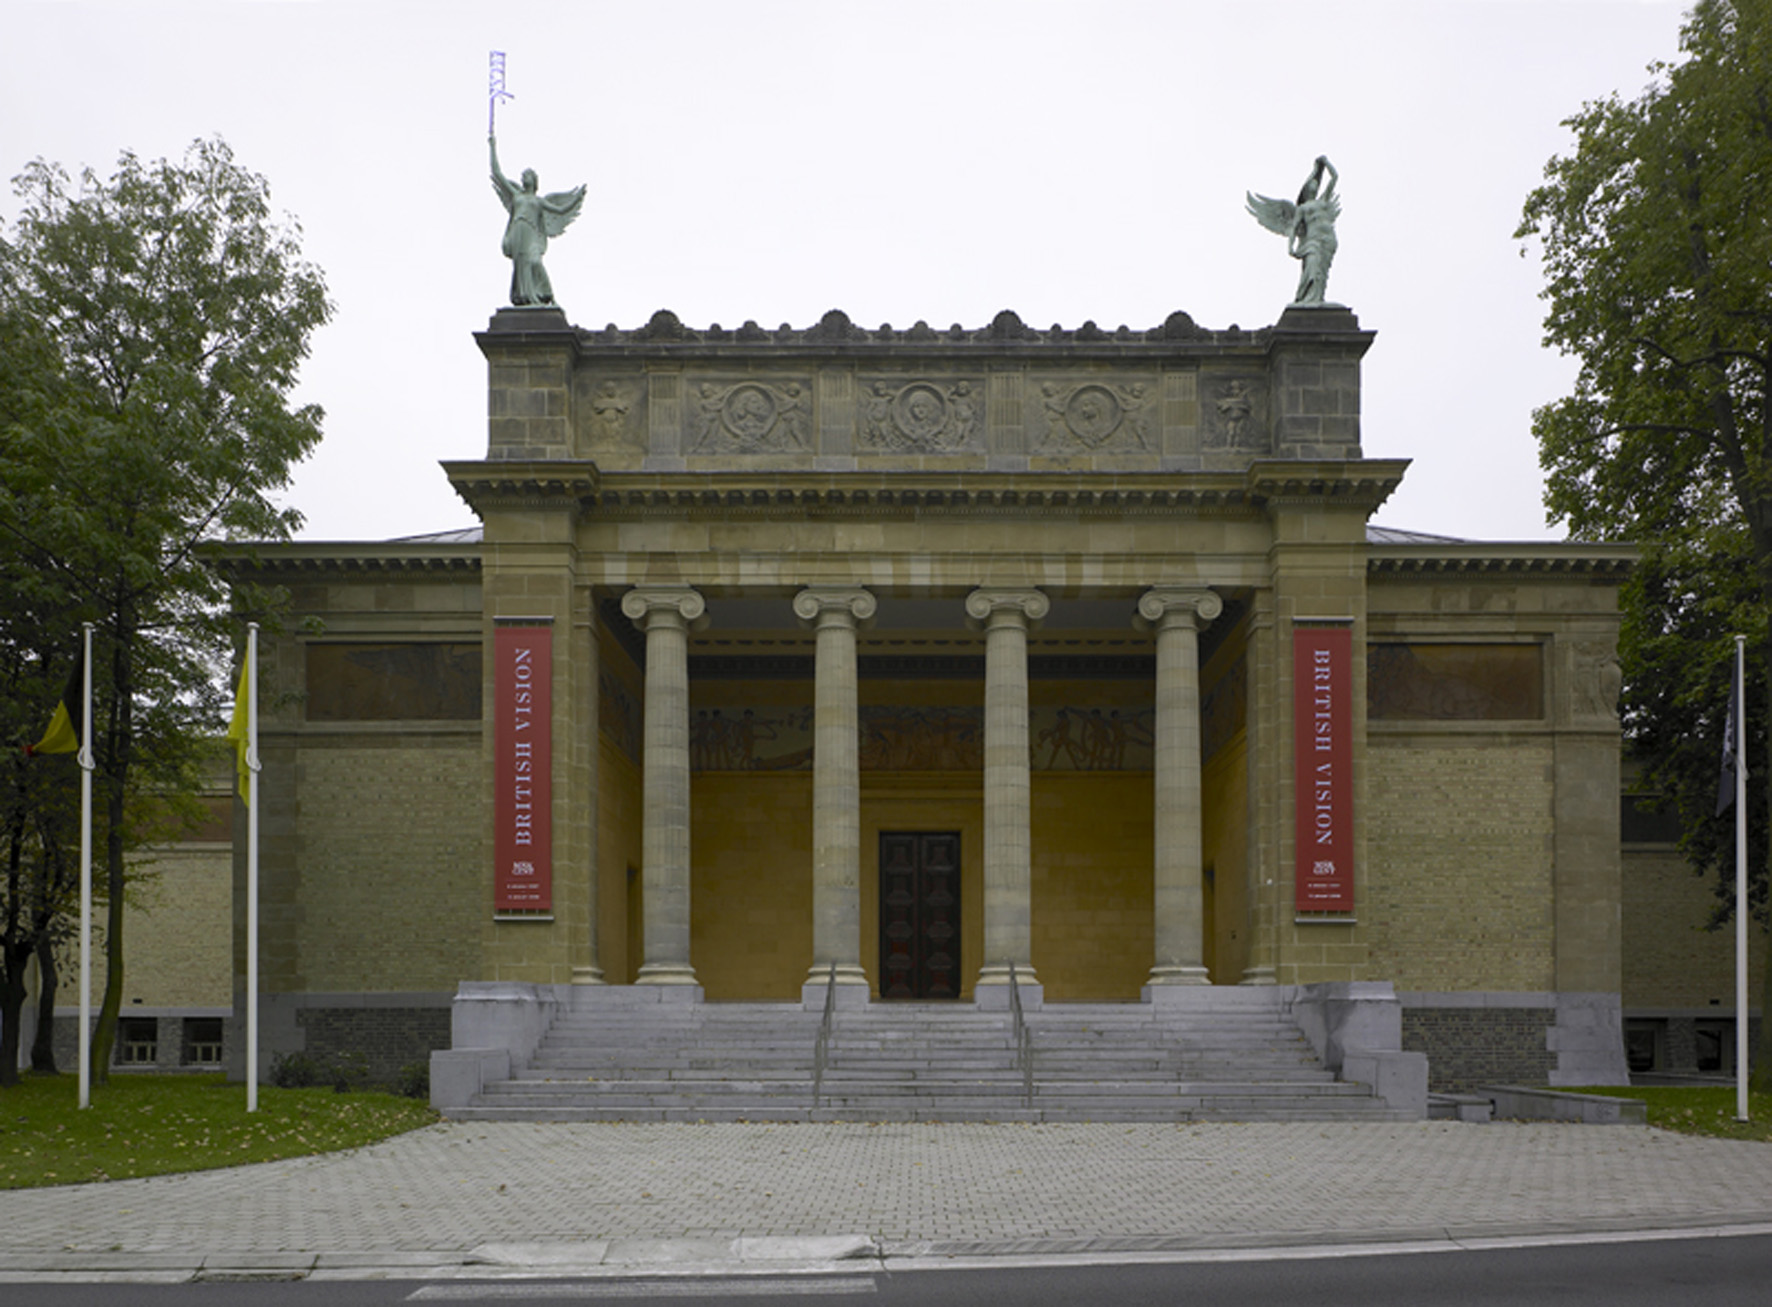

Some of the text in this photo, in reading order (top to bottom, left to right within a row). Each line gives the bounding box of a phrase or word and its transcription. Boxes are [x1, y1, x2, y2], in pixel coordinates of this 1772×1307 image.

[515, 648, 532, 731] VISION
[1315, 650, 1331, 751] BRITISH
[515, 742, 532, 846] BRITISH
[1316, 763, 1332, 845] VISION
